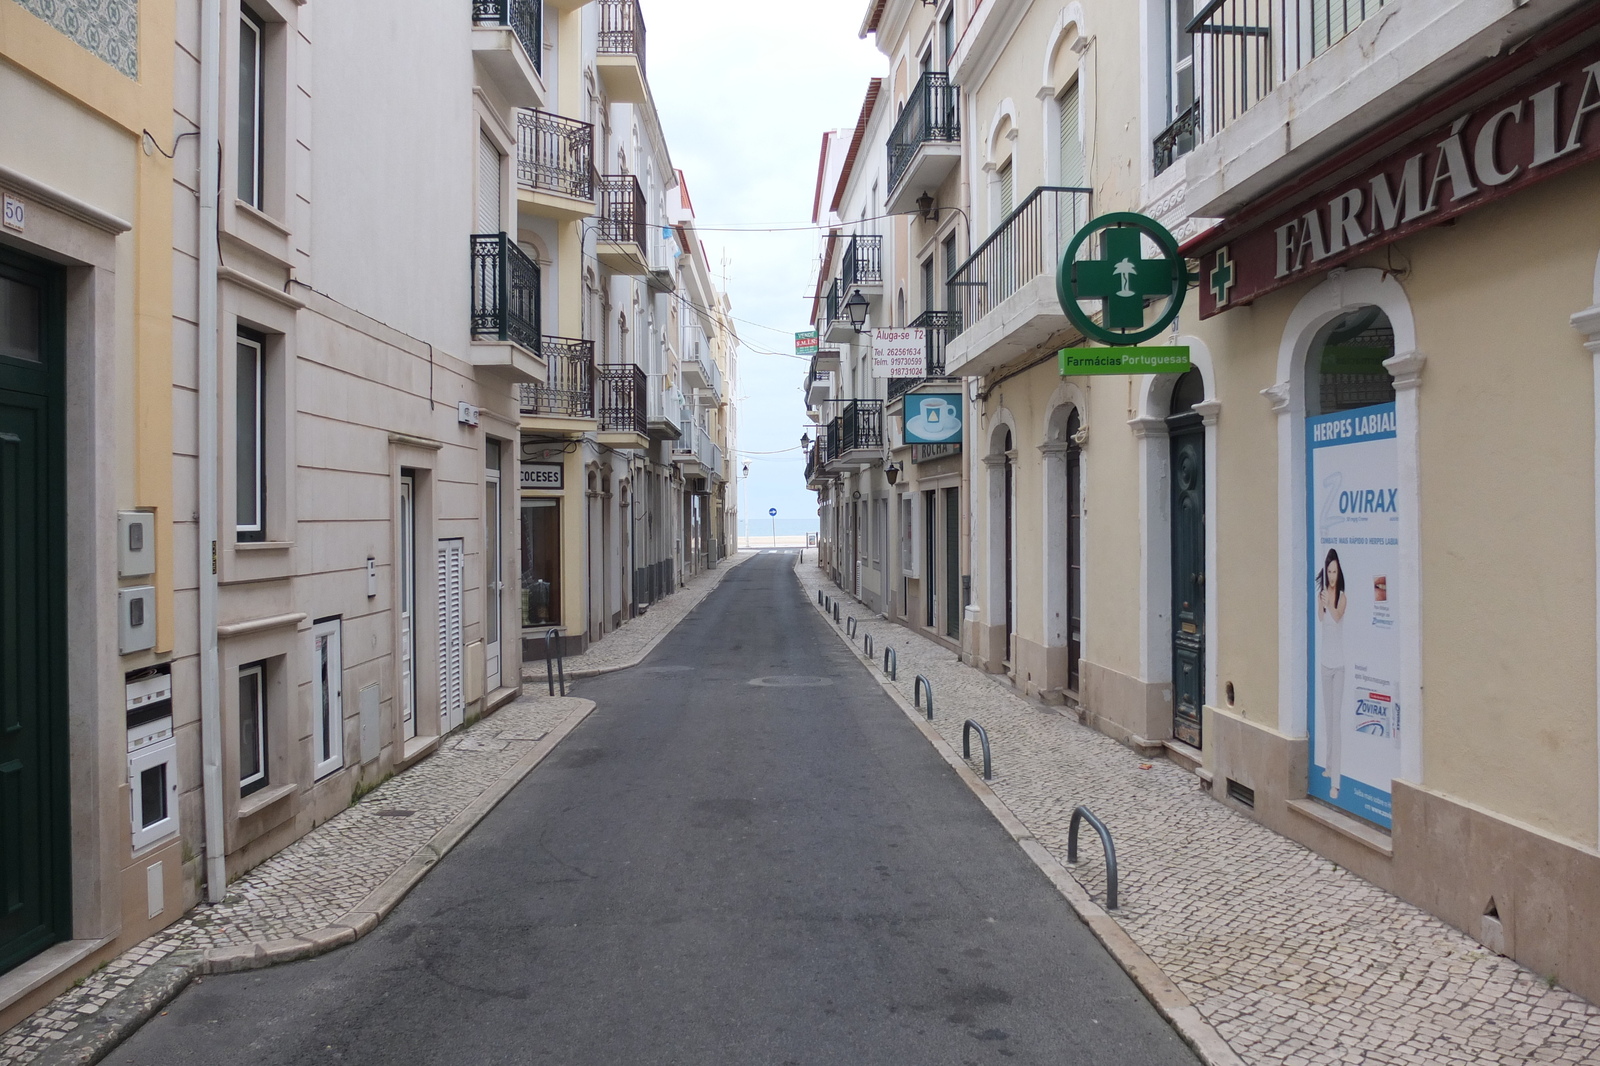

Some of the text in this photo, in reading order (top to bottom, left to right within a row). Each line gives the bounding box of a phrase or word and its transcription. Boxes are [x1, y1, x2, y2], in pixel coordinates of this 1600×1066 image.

[1274, 60, 1600, 280] FARMÁCIA
[6, 201, 23, 222] 50
[876, 330, 924, 342] Aluga-se T2
[874, 348, 885, 357] Tel.
[1066, 354, 1188, 367] Farmácias Portuguesas
[1313, 411, 1396, 442] HERPES LABIAL
[921, 444, 948, 459] ROCHA
[1355, 699, 1388, 717] ZOVIRAX
